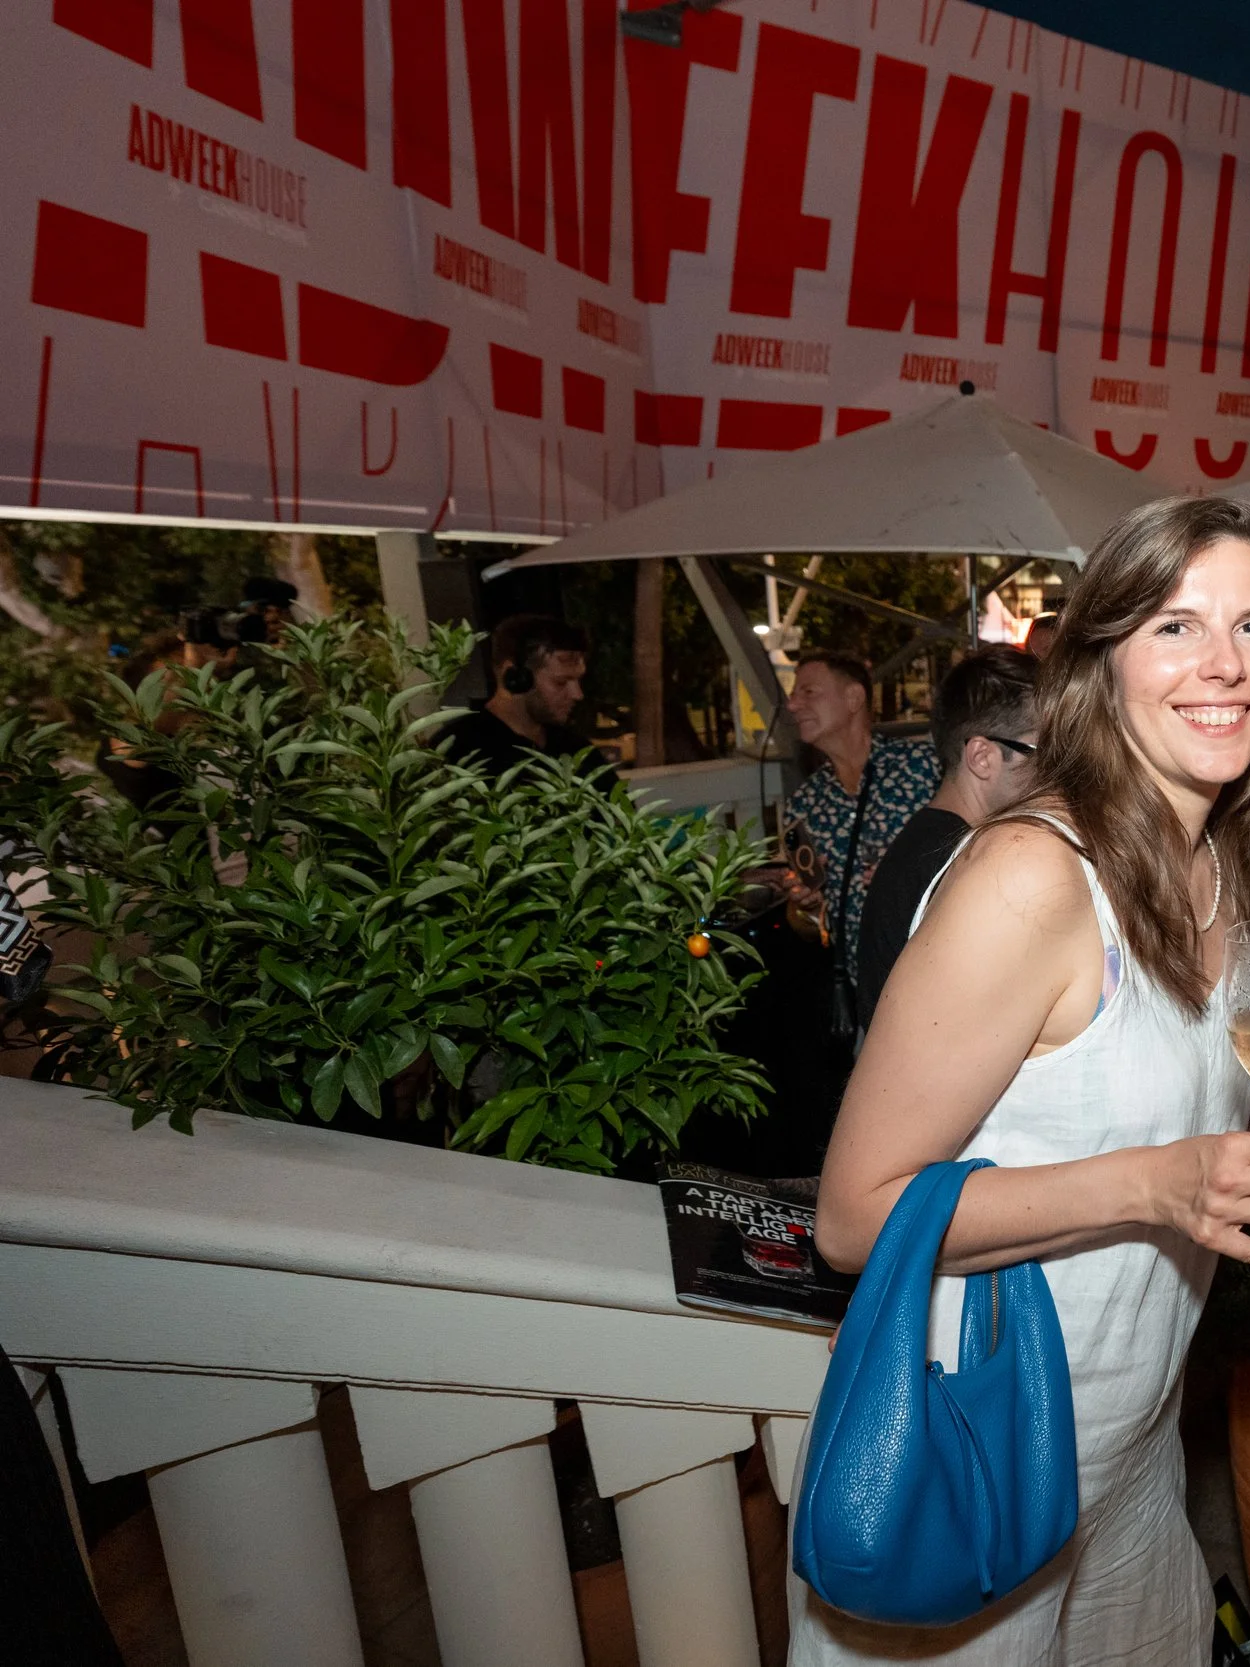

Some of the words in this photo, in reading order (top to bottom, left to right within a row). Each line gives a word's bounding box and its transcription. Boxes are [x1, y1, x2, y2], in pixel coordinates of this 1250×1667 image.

[128, 103, 308, 230] ADWEEKHOUSE
[712, 333, 832, 375] ADWEEKHOUSE
[685, 1187, 704, 1198] A
[708, 1190, 783, 1213] PARTY
[705, 1199, 754, 1216] THE
[746, 1226, 797, 1245] AGE
